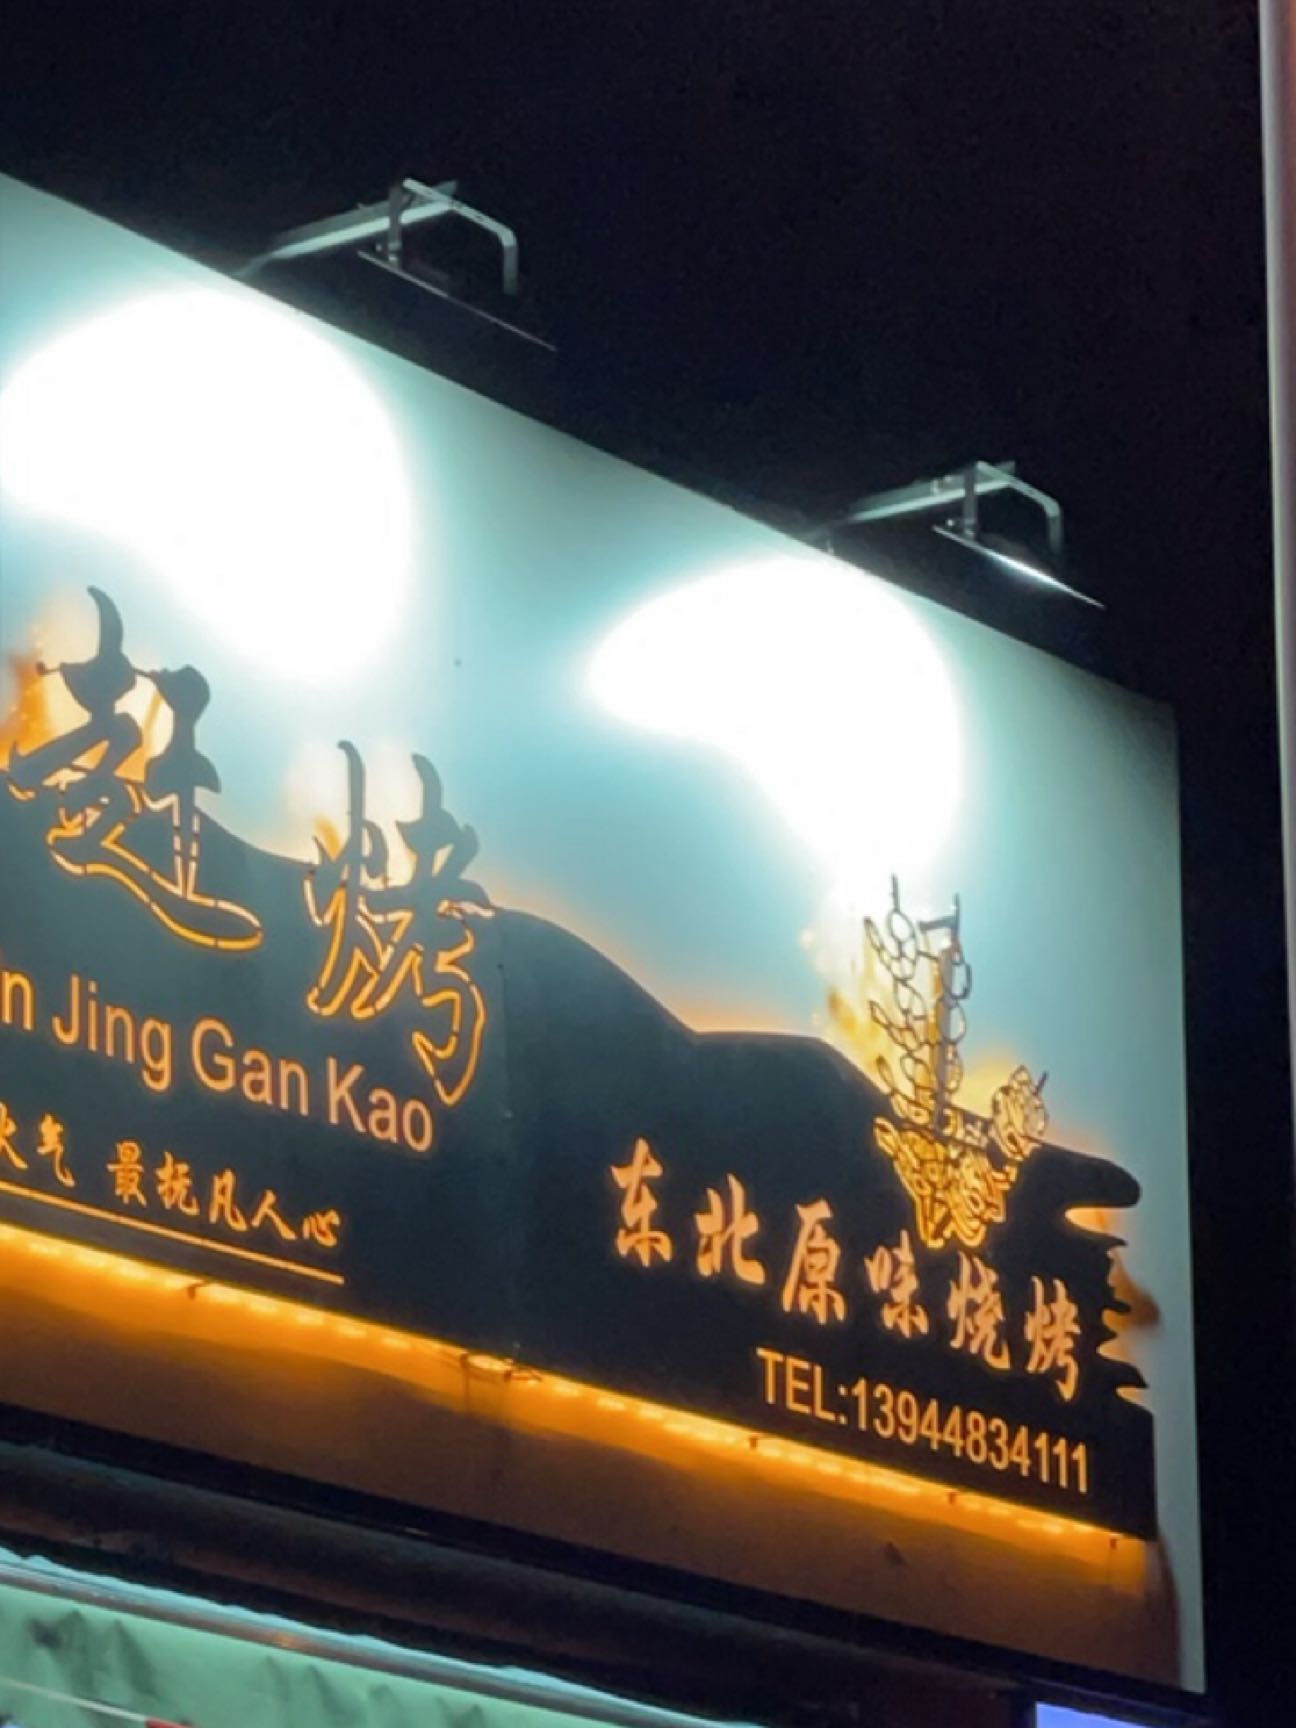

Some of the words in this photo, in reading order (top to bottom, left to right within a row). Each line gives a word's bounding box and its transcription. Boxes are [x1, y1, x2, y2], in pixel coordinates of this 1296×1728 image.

[52, 972, 173, 1092] Jing
[190, 1020, 310, 1116] Gan
[327, 1058, 434, 1152] Kao
[105, 1142, 342, 1248] 最抚凡人心
[610, 1137, 1082, 1402] 东北原味烧烤
[757, 1348, 1089, 1494] TEL:13944834111
